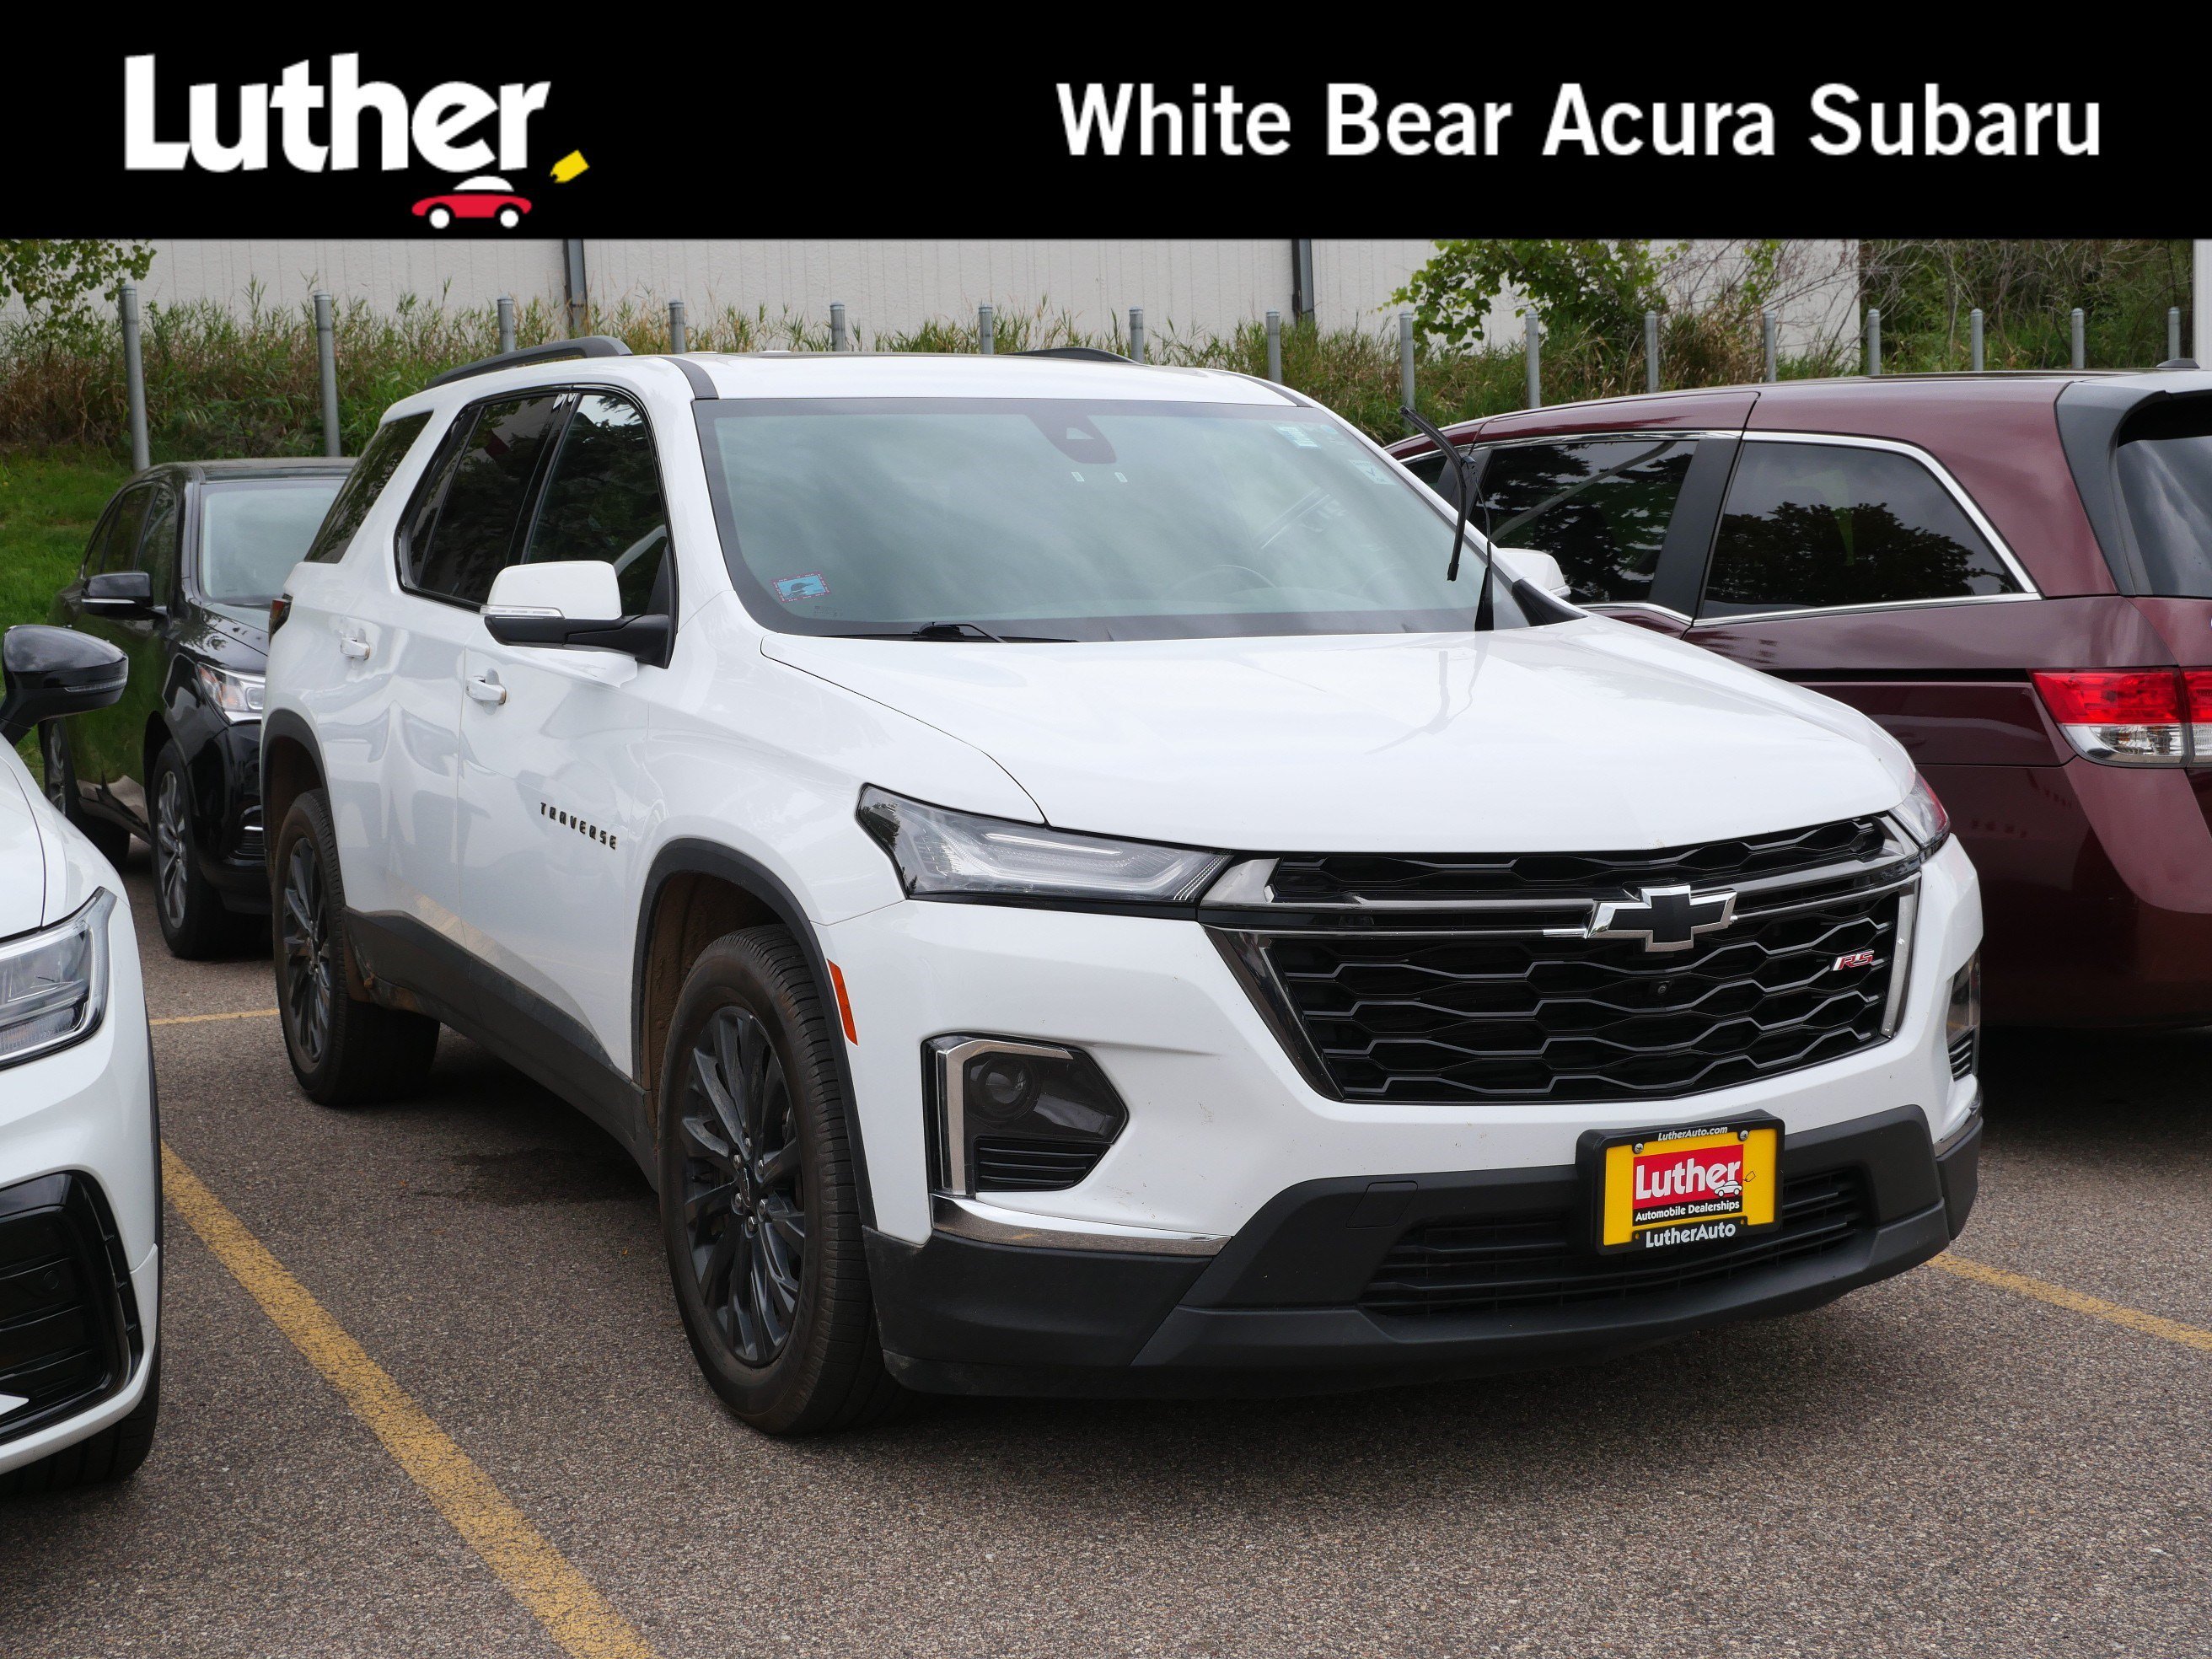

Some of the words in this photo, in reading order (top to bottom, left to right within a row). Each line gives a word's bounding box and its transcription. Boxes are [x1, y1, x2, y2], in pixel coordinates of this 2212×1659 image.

[540, 802, 617, 850] TRAVERSE
[1833, 949, 1875, 971] RS
[1657, 1126, 1728, 1141] LutherAuto.com
[1636, 1158, 1741, 1200] Luther
[1635, 1206, 1686, 1222] Automobile
[1688, 1200, 1740, 1216] Dealerships
[1646, 1223, 1737, 1248] LutherAuto
